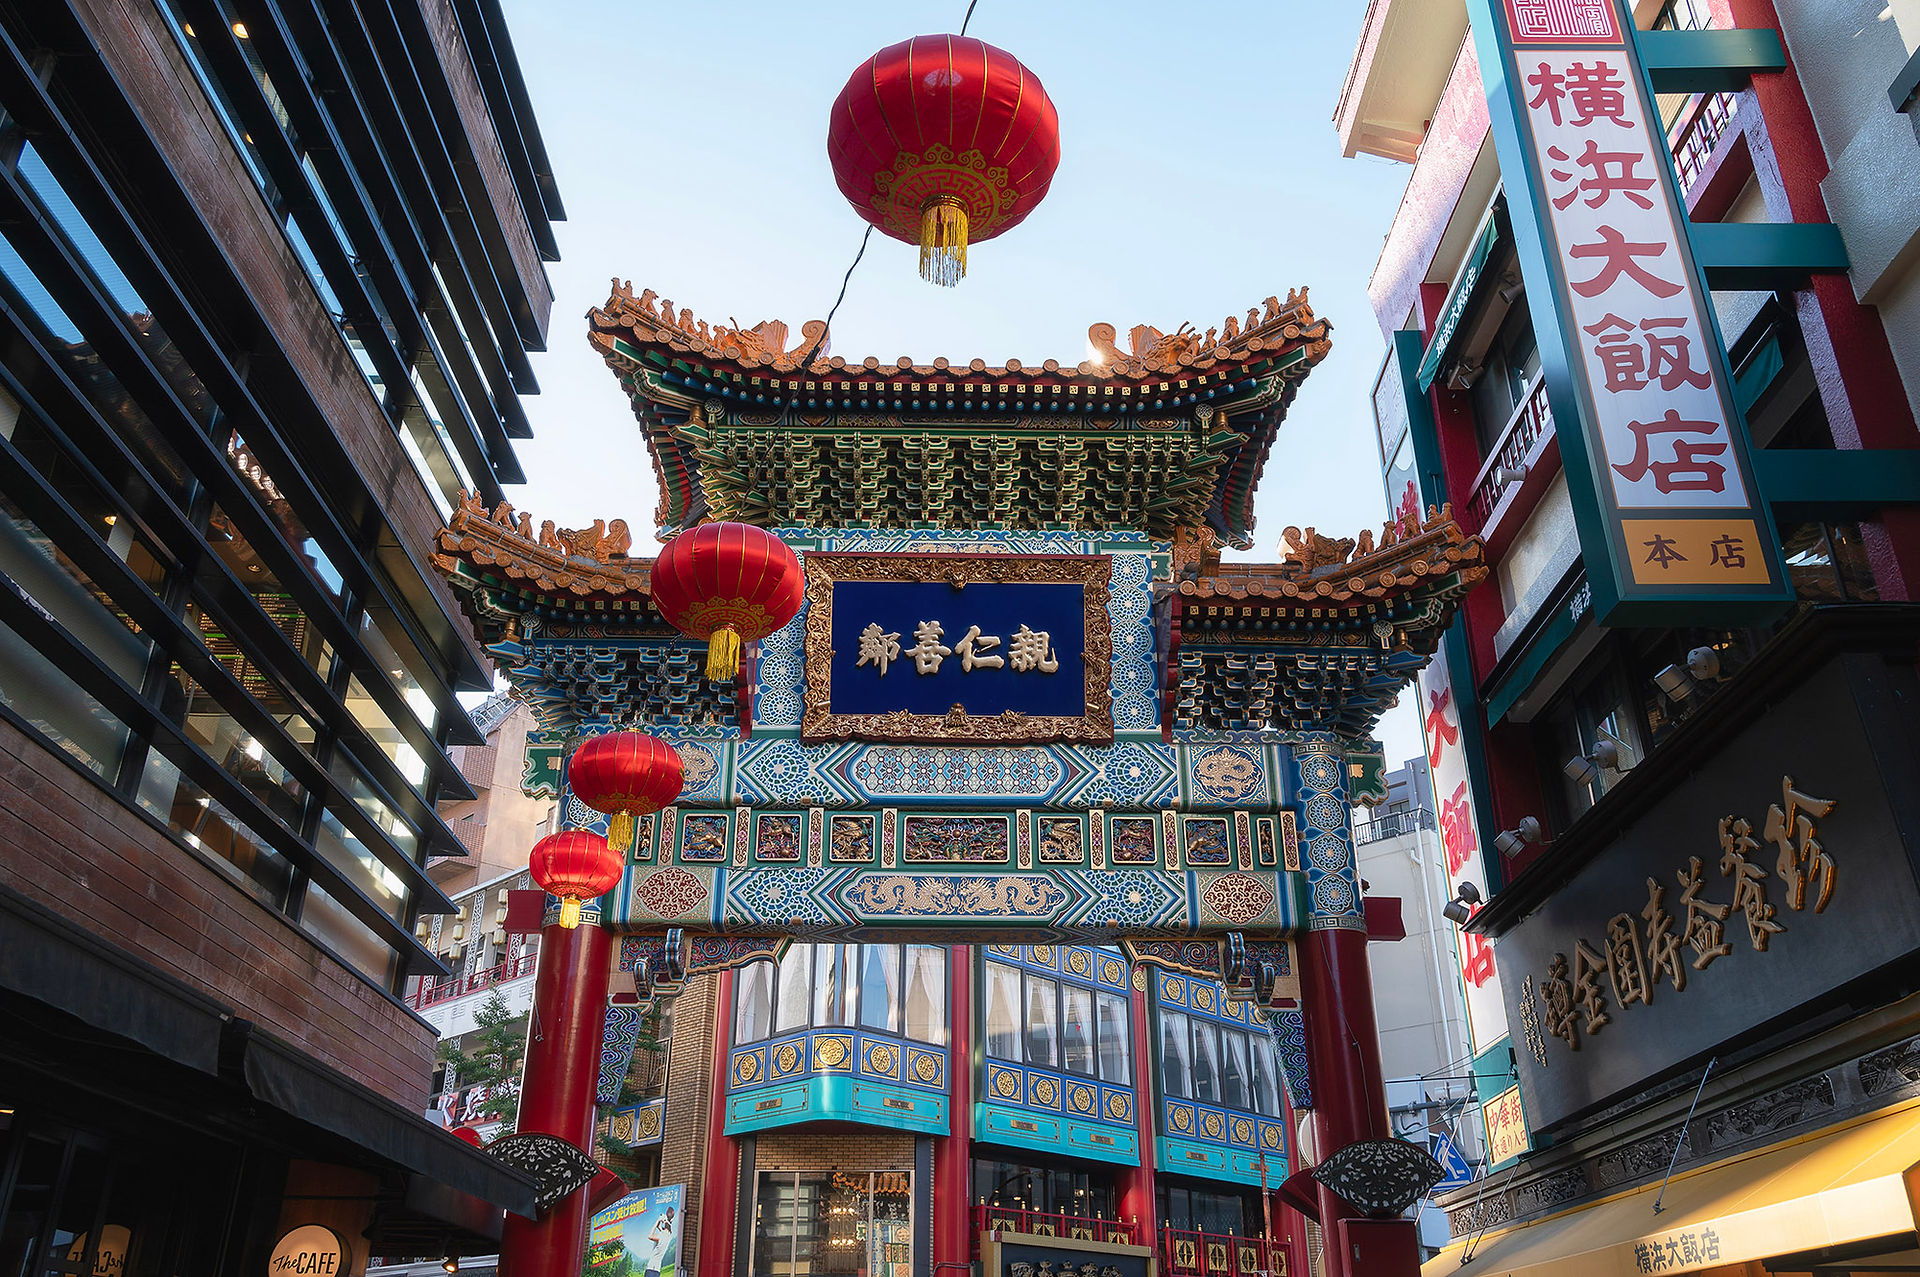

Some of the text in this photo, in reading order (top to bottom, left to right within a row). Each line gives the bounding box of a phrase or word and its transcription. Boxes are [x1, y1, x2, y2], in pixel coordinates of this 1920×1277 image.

[1527, 61, 1728, 495] 横浜大飯店
[1643, 534, 1747, 570] 本店
[272, 1251, 337, 1275] The CAFE
[1634, 1227, 1720, 1274] 横浜大飯店
